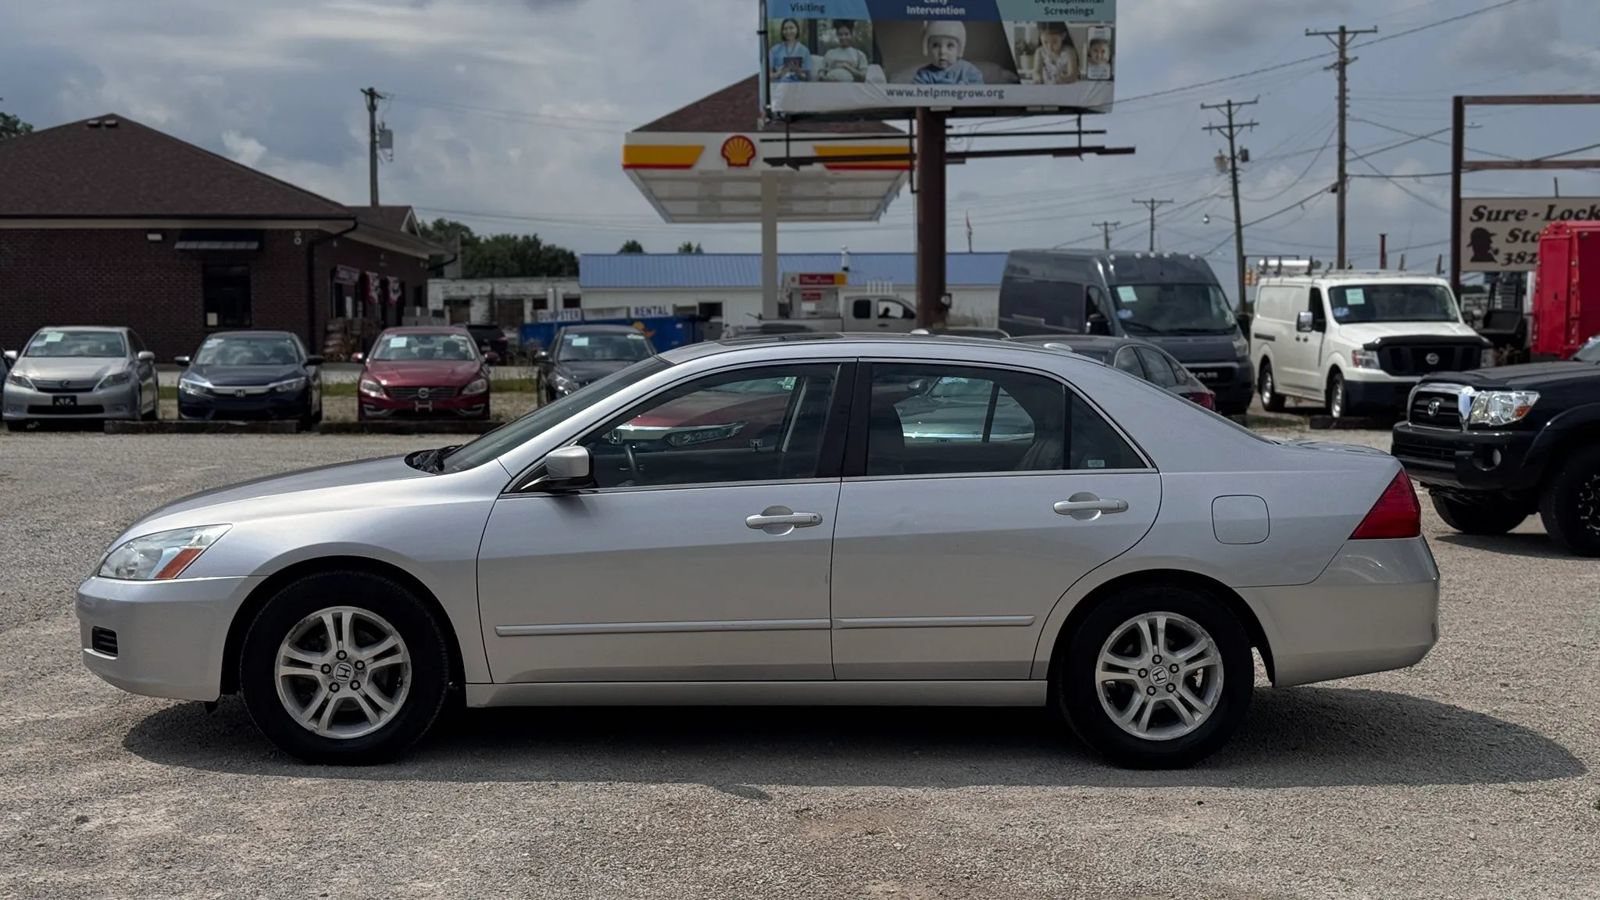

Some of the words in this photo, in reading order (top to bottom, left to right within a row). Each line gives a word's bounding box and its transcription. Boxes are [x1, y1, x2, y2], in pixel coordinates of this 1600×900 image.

[789, 2, 826, 14] Visiting
[906, 5, 966, 16] Intervention
[1044, 6, 1094, 17] Screenings
[886, 87, 1005, 100] www.helpmegrow.org
[634, 305, 669, 317] RENTAL
